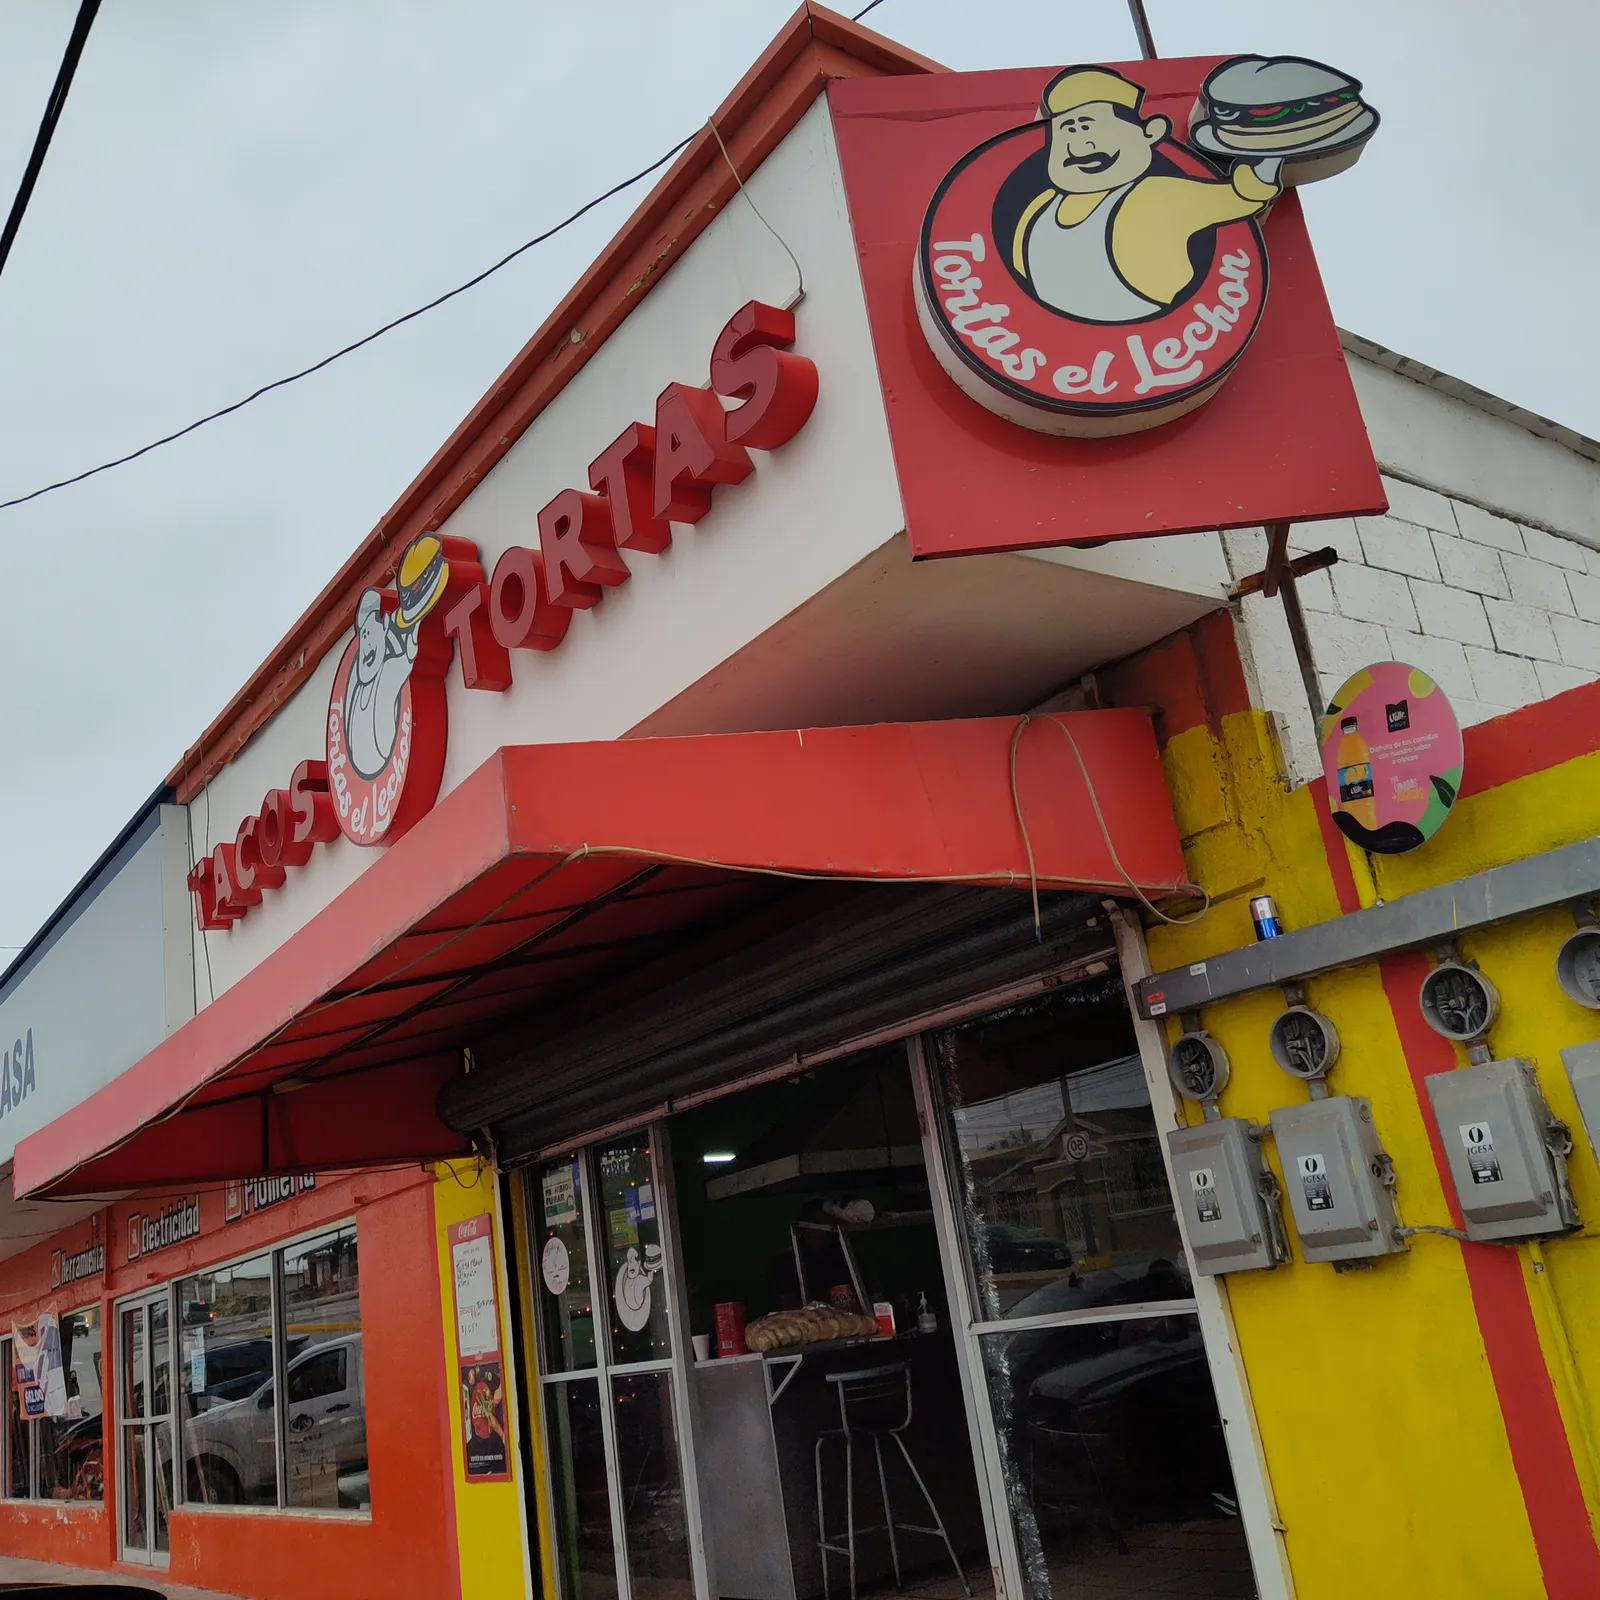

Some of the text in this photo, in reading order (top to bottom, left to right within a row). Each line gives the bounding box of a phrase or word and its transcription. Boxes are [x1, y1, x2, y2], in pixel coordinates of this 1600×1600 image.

[932, 232, 1252, 396] Tortas el Lechon
[187, 300, 818, 931] TACOS TORTAS
[329, 696, 412, 838] Tortas el Lechon
[1303, 1173, 1327, 1183] IGESA
[1468, 1144, 1494, 1155] IGESA
[1195, 1187, 1216, 1198] IGESA
[141, 1193, 200, 1254] Electricidad
